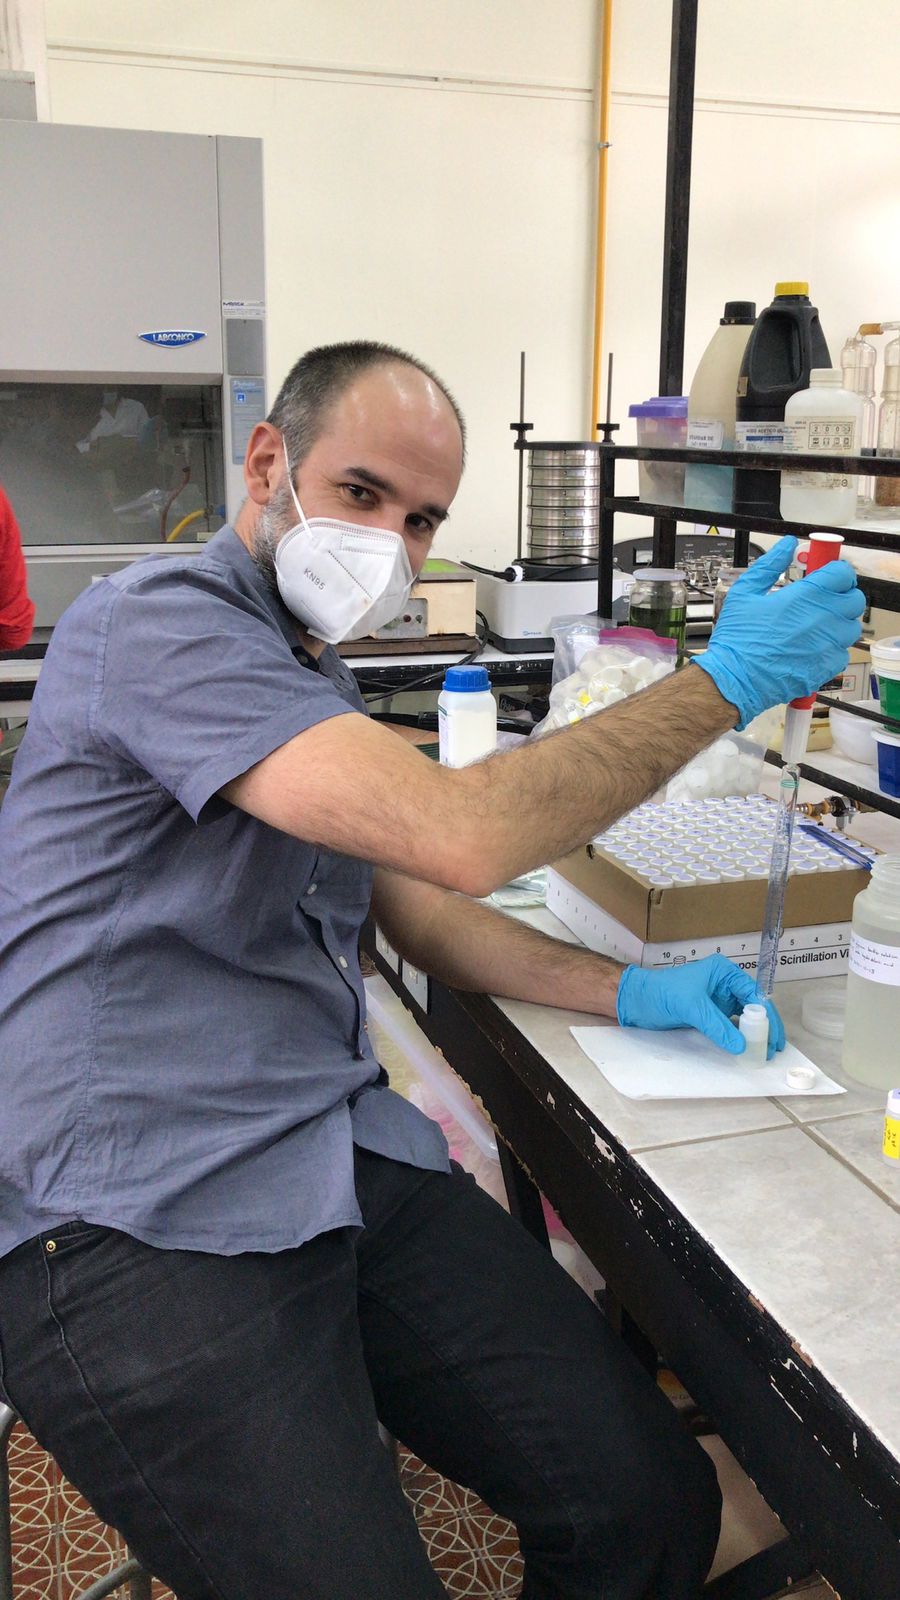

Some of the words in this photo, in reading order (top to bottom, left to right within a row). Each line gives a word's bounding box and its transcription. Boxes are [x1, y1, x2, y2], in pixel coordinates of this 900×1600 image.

[152, 333, 194, 342] LABCONCO
[304, 567, 326, 590] KN95
[662, 951, 671, 959] 10
[780, 951, 838, 965] Scintillation
